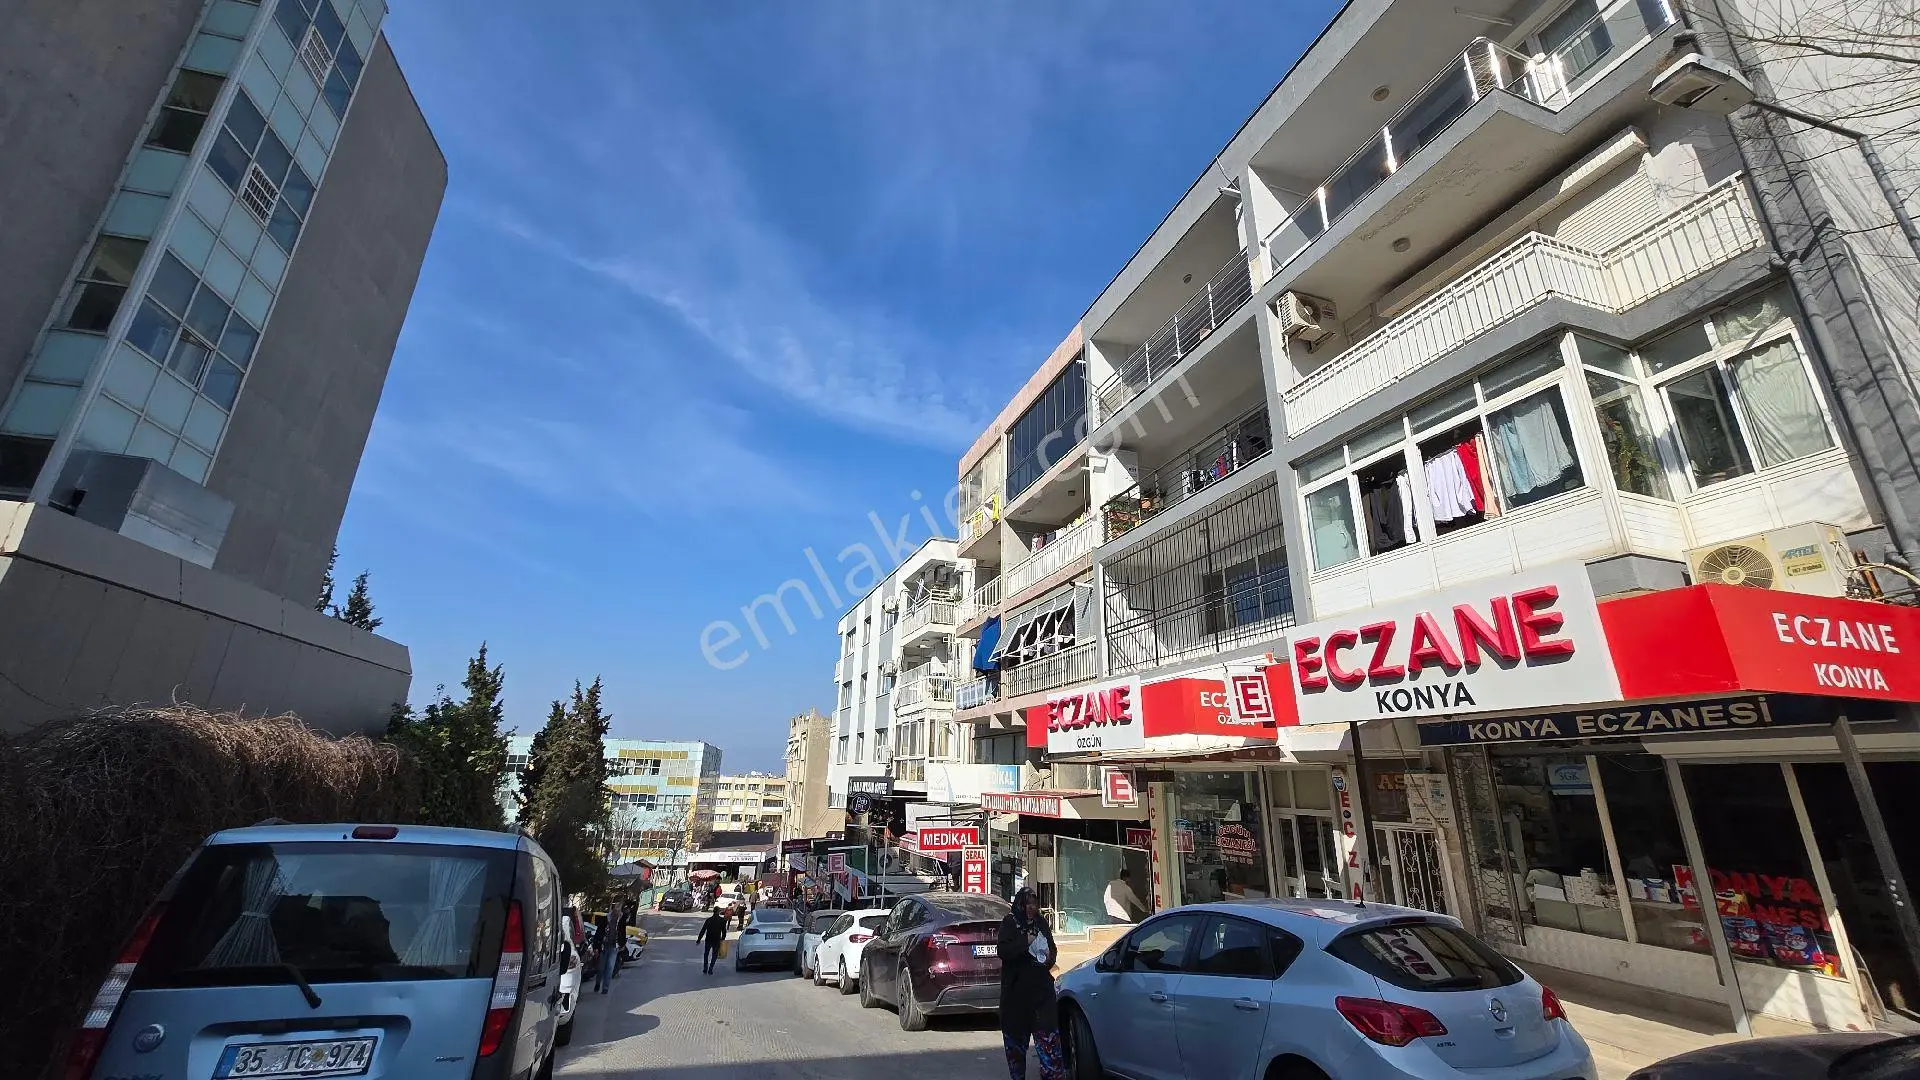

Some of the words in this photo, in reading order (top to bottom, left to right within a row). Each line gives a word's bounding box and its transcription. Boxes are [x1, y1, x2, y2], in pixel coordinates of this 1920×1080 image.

[1293, 585, 1576, 690] ECZANE
[1772, 612, 1900, 653] ECZANE
[1813, 662, 1890, 691] KONYA
[1047, 685, 1132, 733] ECZANE
[1240, 682, 1263, 711] E
[1376, 681, 1476, 713] KONYA
[1468, 719, 1561, 740] KONYA
[1575, 696, 1773, 734] ECZANESİ
[1110, 773, 1131, 801] E
[923, 829, 974, 846] MEDİKAL
[235, 1048, 267, 1073] 35
[280, 1046, 312, 1070] TC
[326, 1043, 368, 1068] 974
